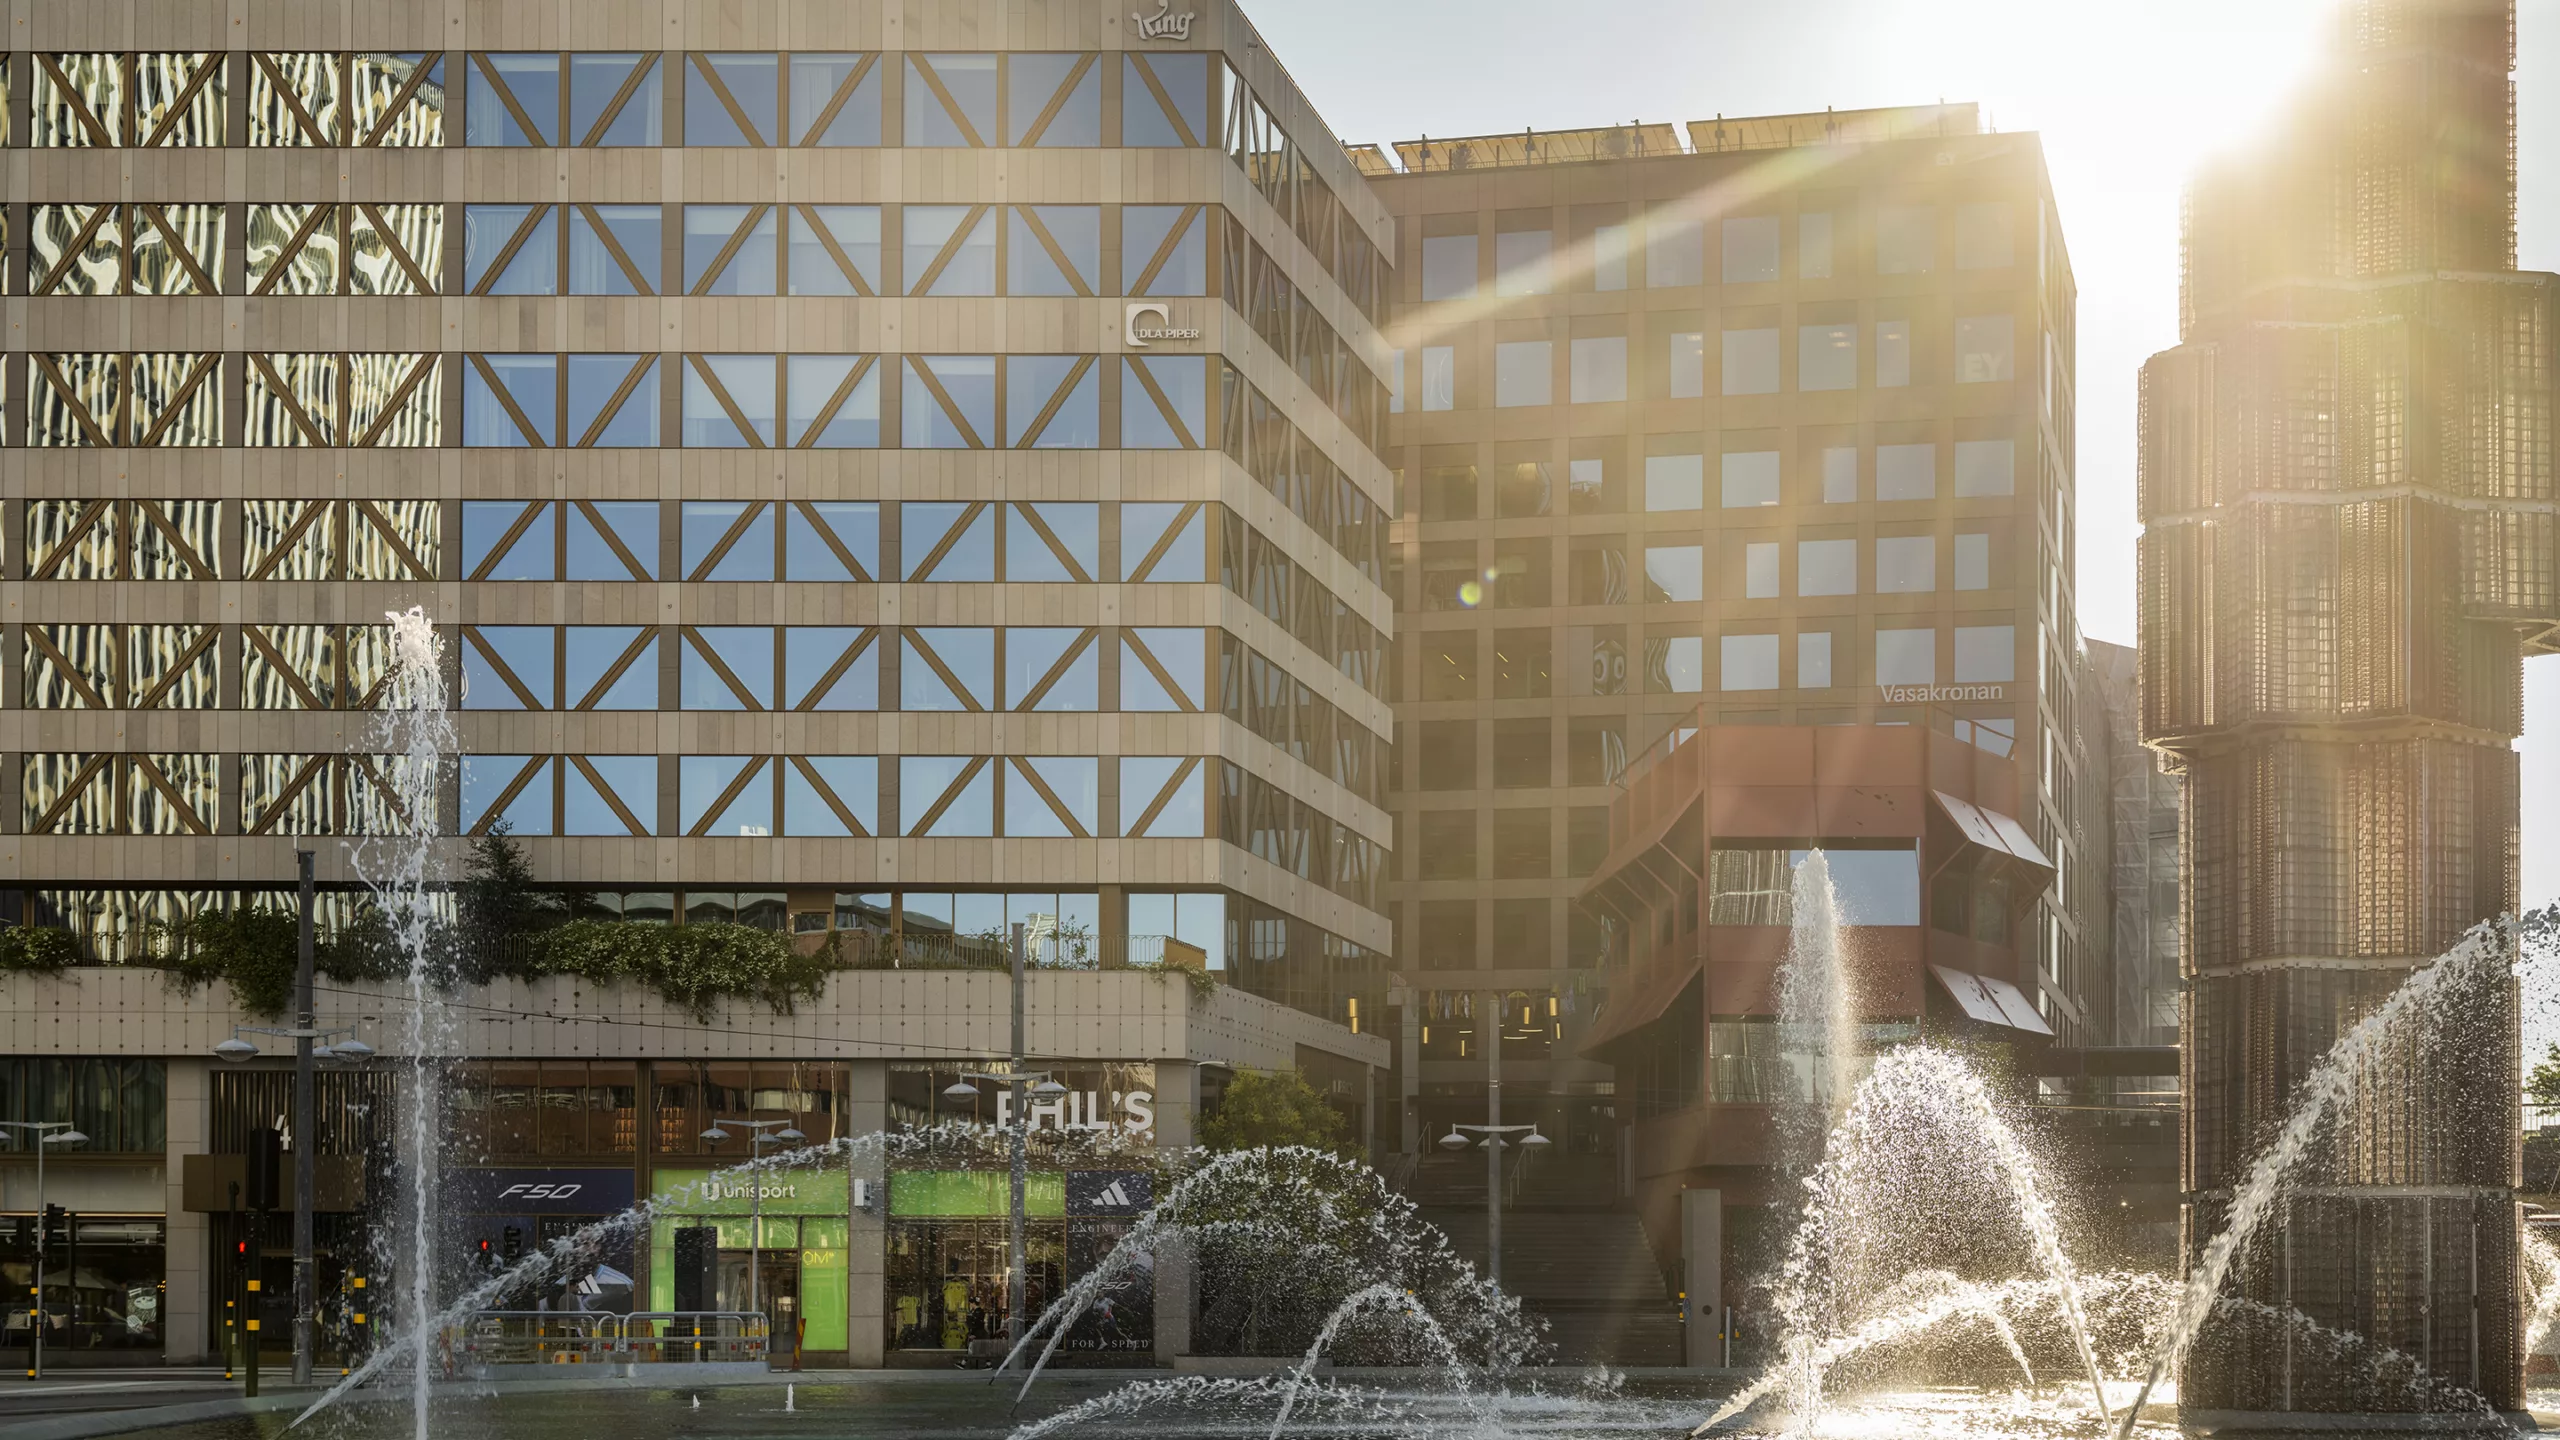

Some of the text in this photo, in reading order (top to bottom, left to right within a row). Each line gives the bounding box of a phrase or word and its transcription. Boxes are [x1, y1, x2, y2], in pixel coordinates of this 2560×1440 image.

[1131, 0, 1194, 40] King
[1140, 328, 1199, 339] DLA PIPER
[1880, 682, 2003, 702] Vasakronan
[497, 1184, 582, 1199] F50
[1072, 1340, 1095, 1348] FOR
